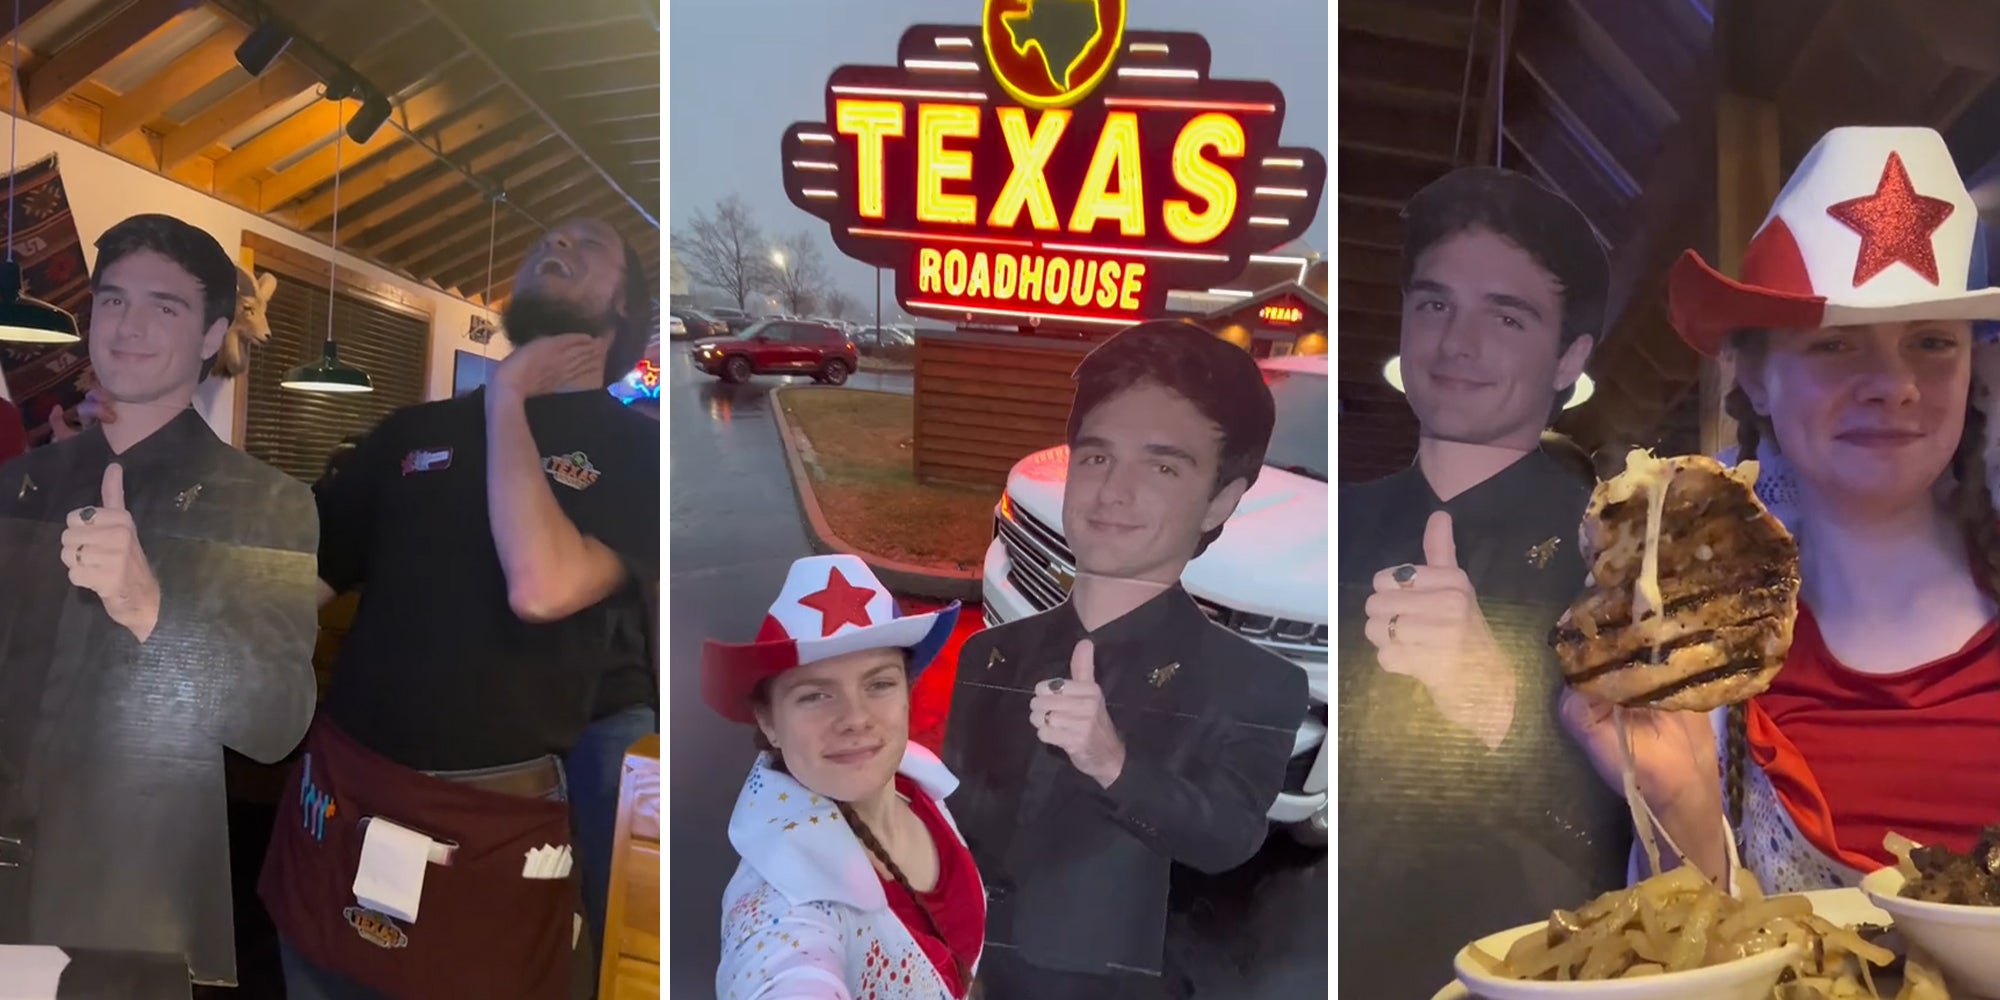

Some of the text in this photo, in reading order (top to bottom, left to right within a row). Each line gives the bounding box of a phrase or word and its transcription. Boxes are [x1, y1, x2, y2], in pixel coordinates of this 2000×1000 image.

[836, 99, 1246, 243] TEXAS
[919, 248, 1146, 310] ROADHOUSE
[1265, 306, 1299, 322] TEXAS
[551, 457, 599, 483] TEXAS
